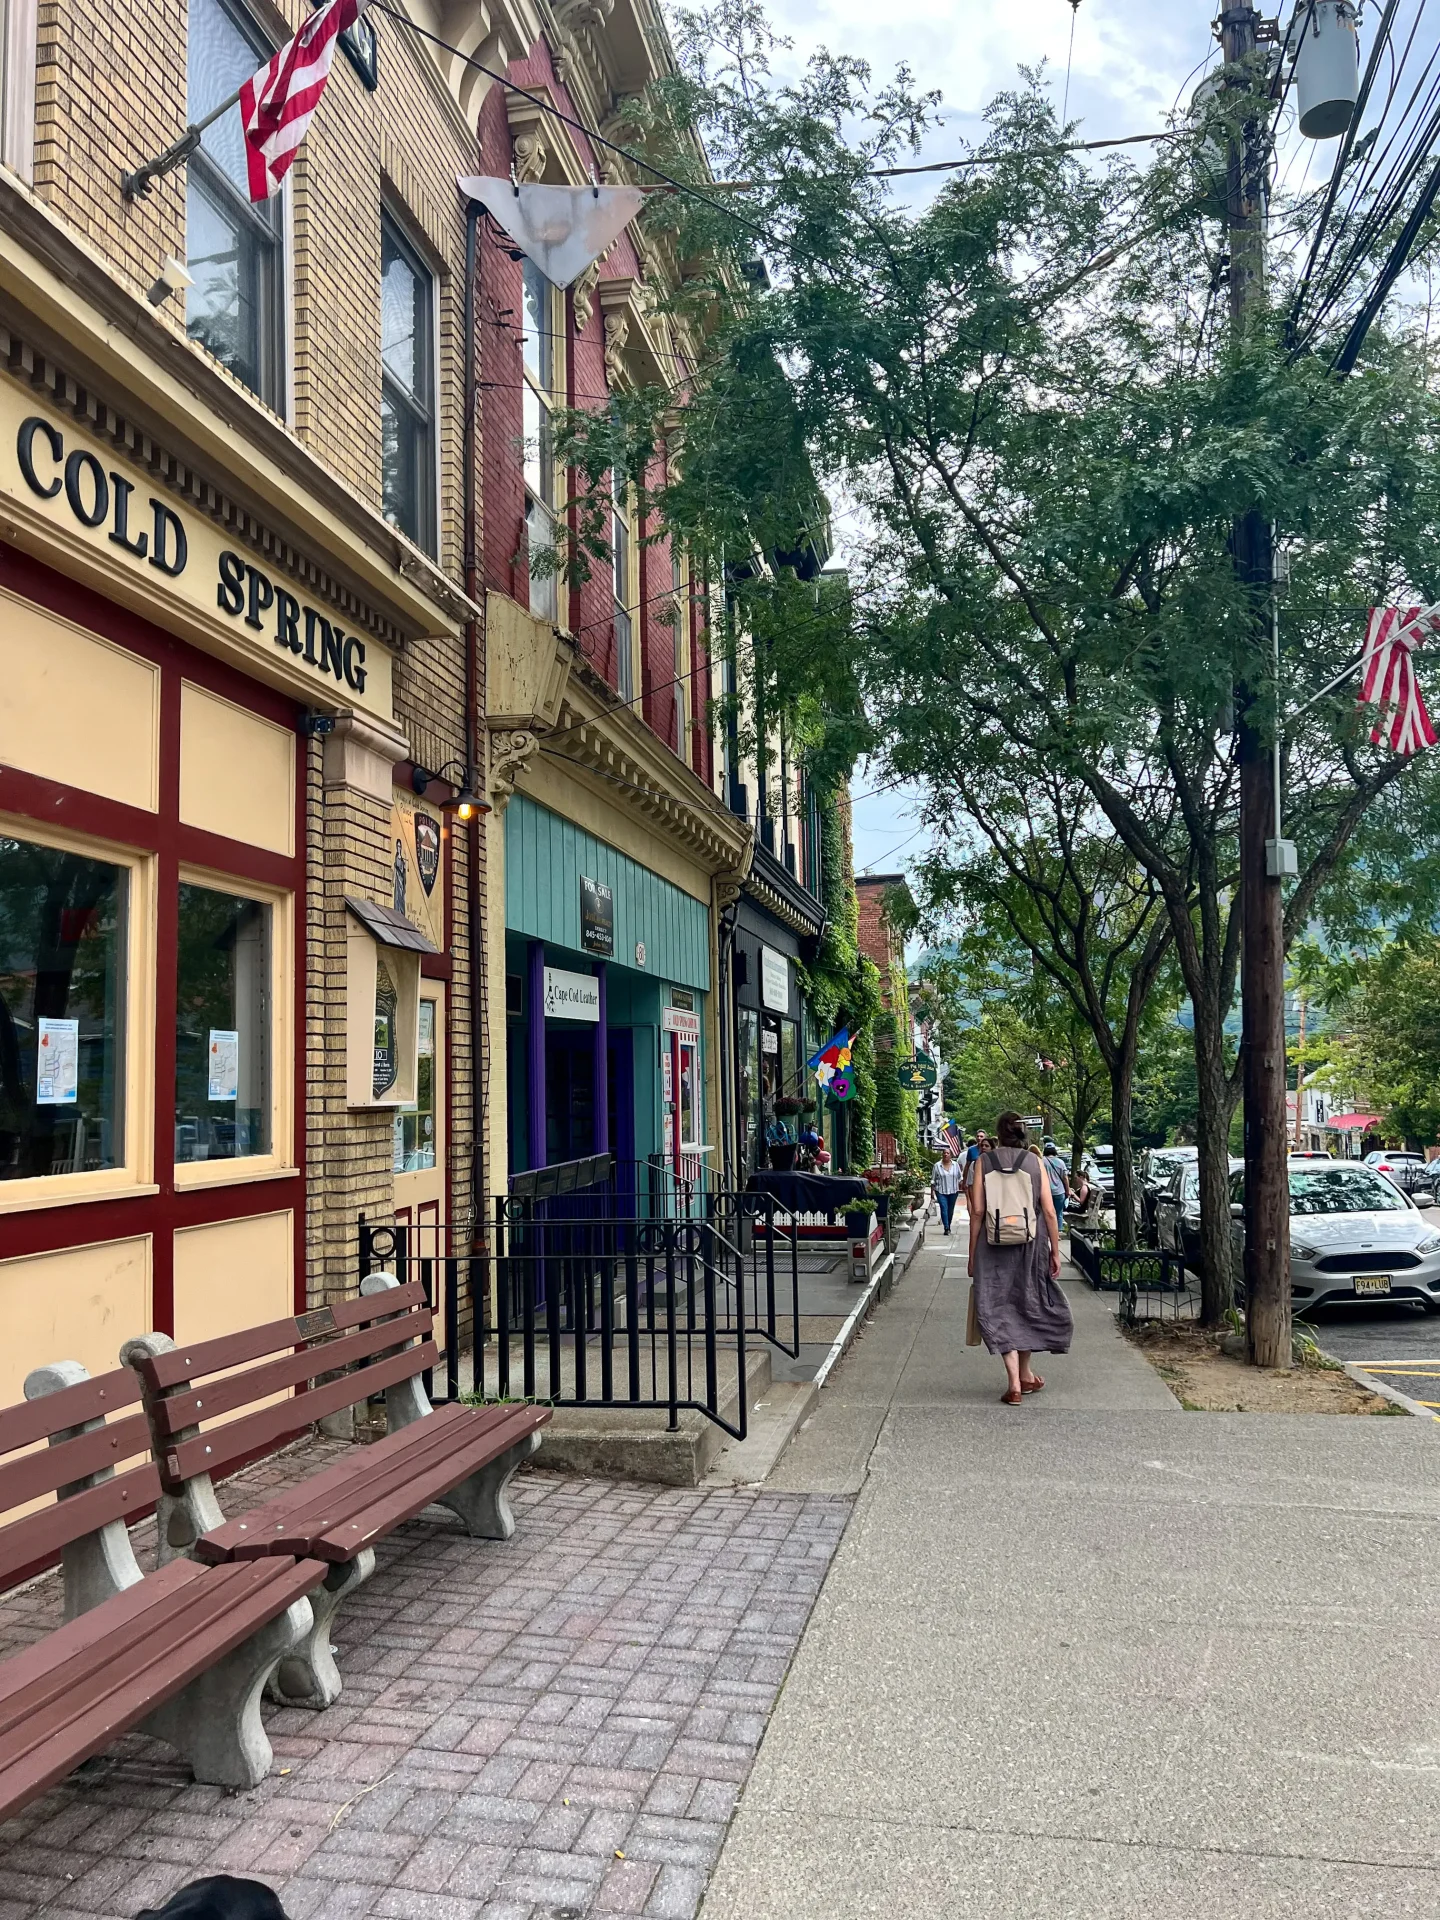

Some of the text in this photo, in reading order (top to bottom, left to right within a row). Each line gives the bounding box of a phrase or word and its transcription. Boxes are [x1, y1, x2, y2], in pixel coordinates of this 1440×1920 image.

[16, 416, 368, 694] COLD SPRING
[418, 816, 437, 831] POLICE
[584, 880, 612, 900] FOR SALE
[554, 985, 597, 1005] Cape Cod Leather
